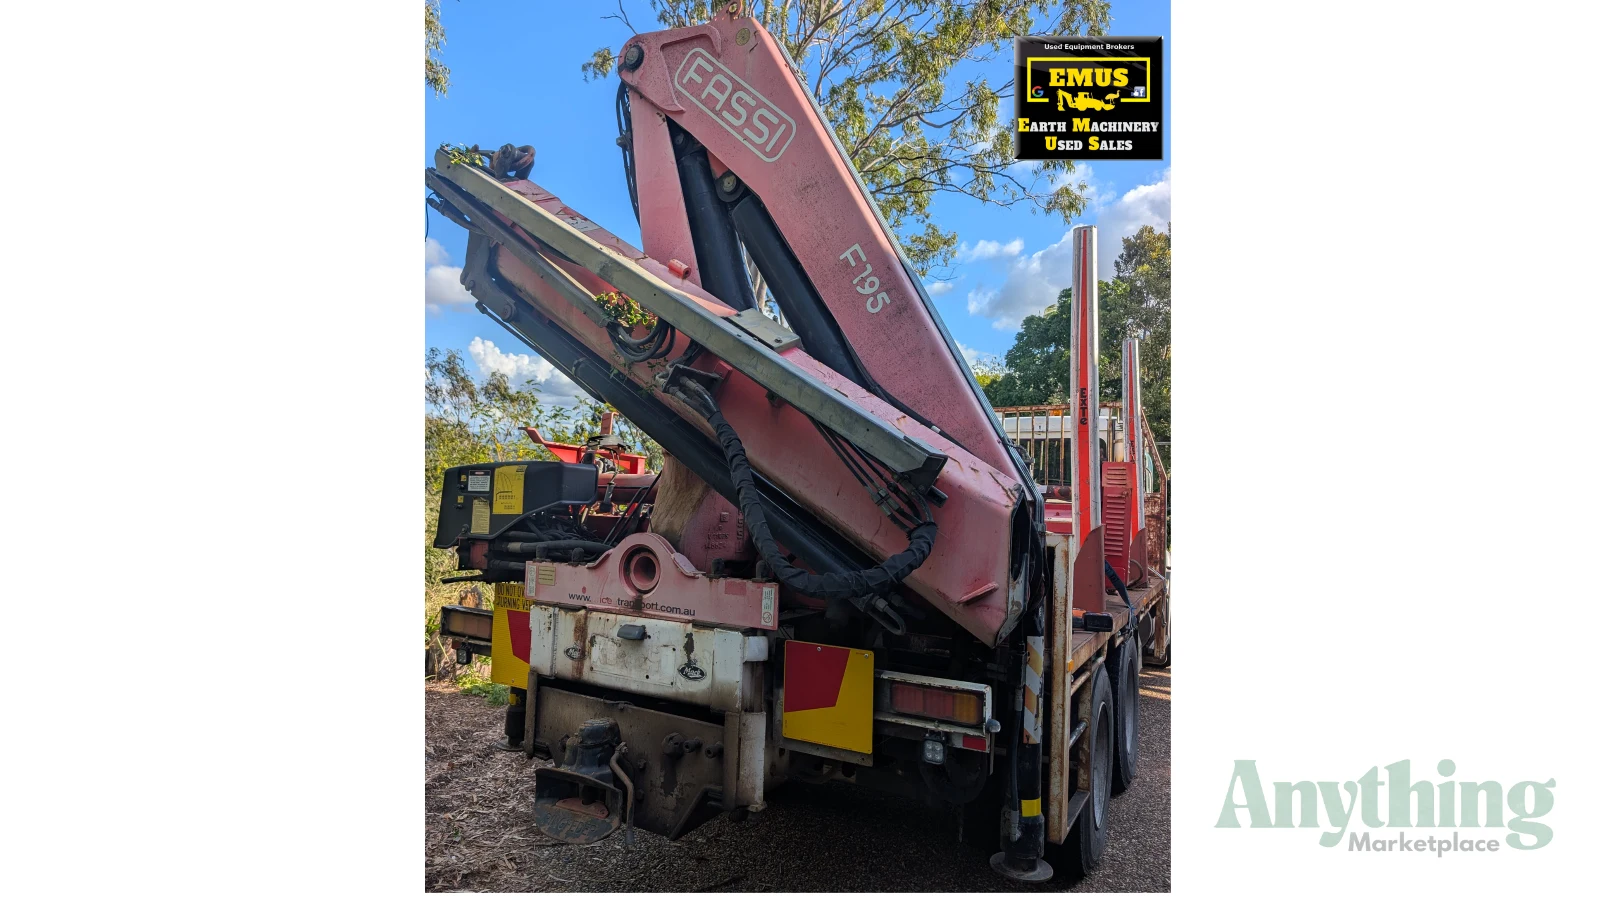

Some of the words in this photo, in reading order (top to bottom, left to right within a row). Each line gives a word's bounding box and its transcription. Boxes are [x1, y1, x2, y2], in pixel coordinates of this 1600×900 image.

[683, 56, 786, 152] FASSI
[839, 243, 890, 314] F195
[617, 598, 696, 616] tranport.com.au
